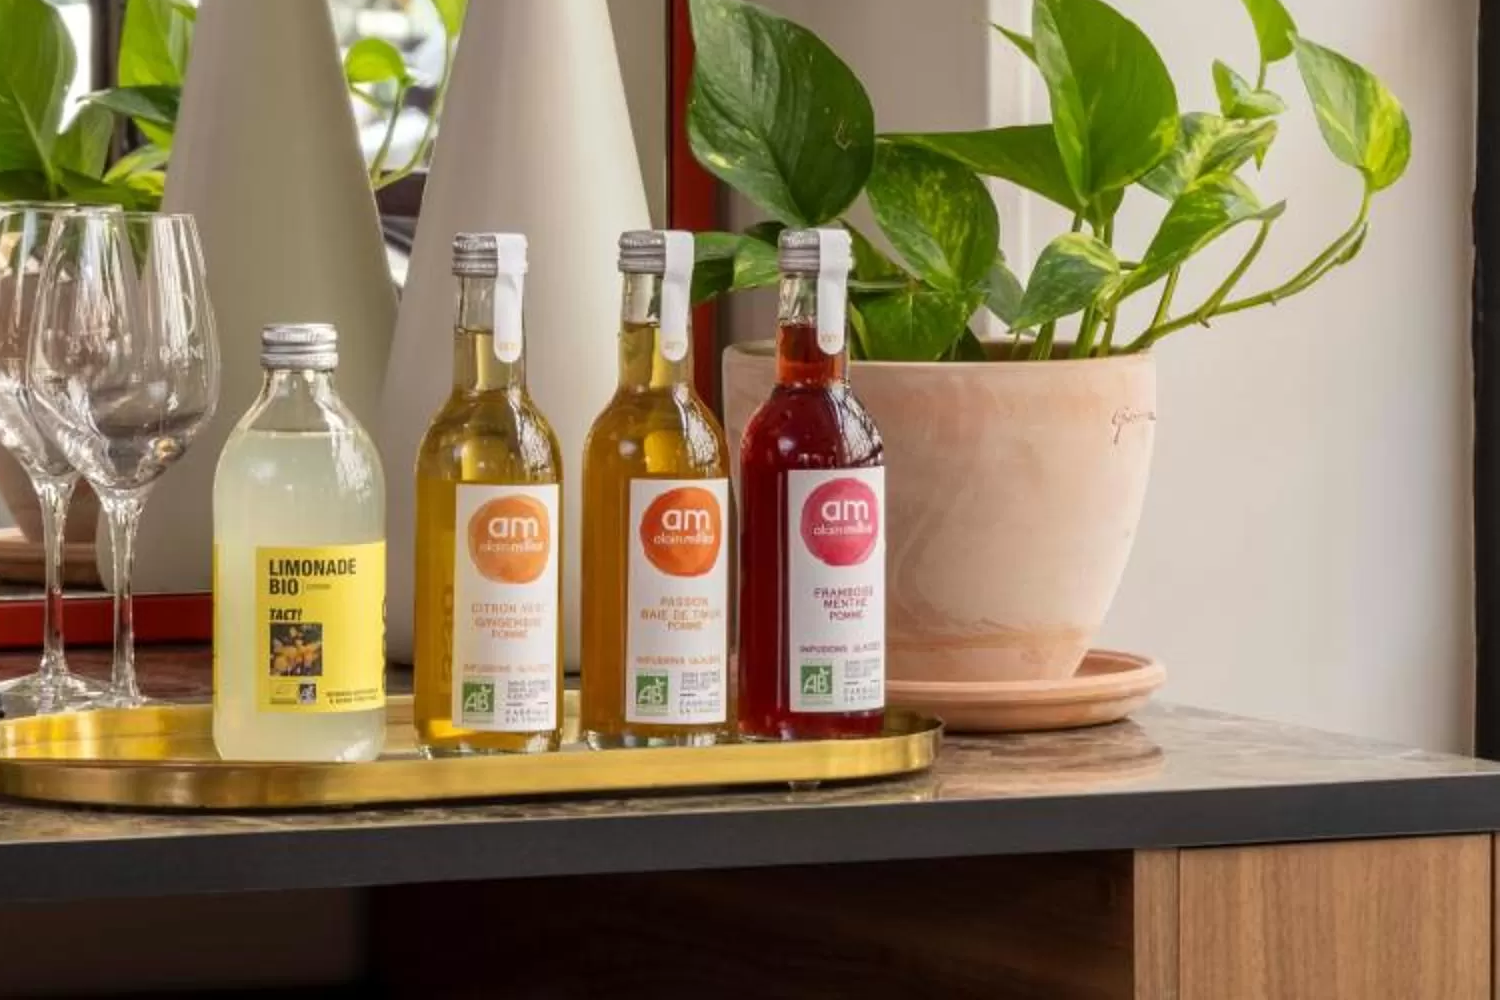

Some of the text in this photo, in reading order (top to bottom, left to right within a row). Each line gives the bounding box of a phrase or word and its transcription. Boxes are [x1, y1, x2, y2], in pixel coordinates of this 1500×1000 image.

[661, 508, 711, 531] am
[821, 499, 869, 521] am
[487, 516, 539, 539] am
[268, 558, 357, 577] LIMONADE
[268, 579, 299, 596] BIO
